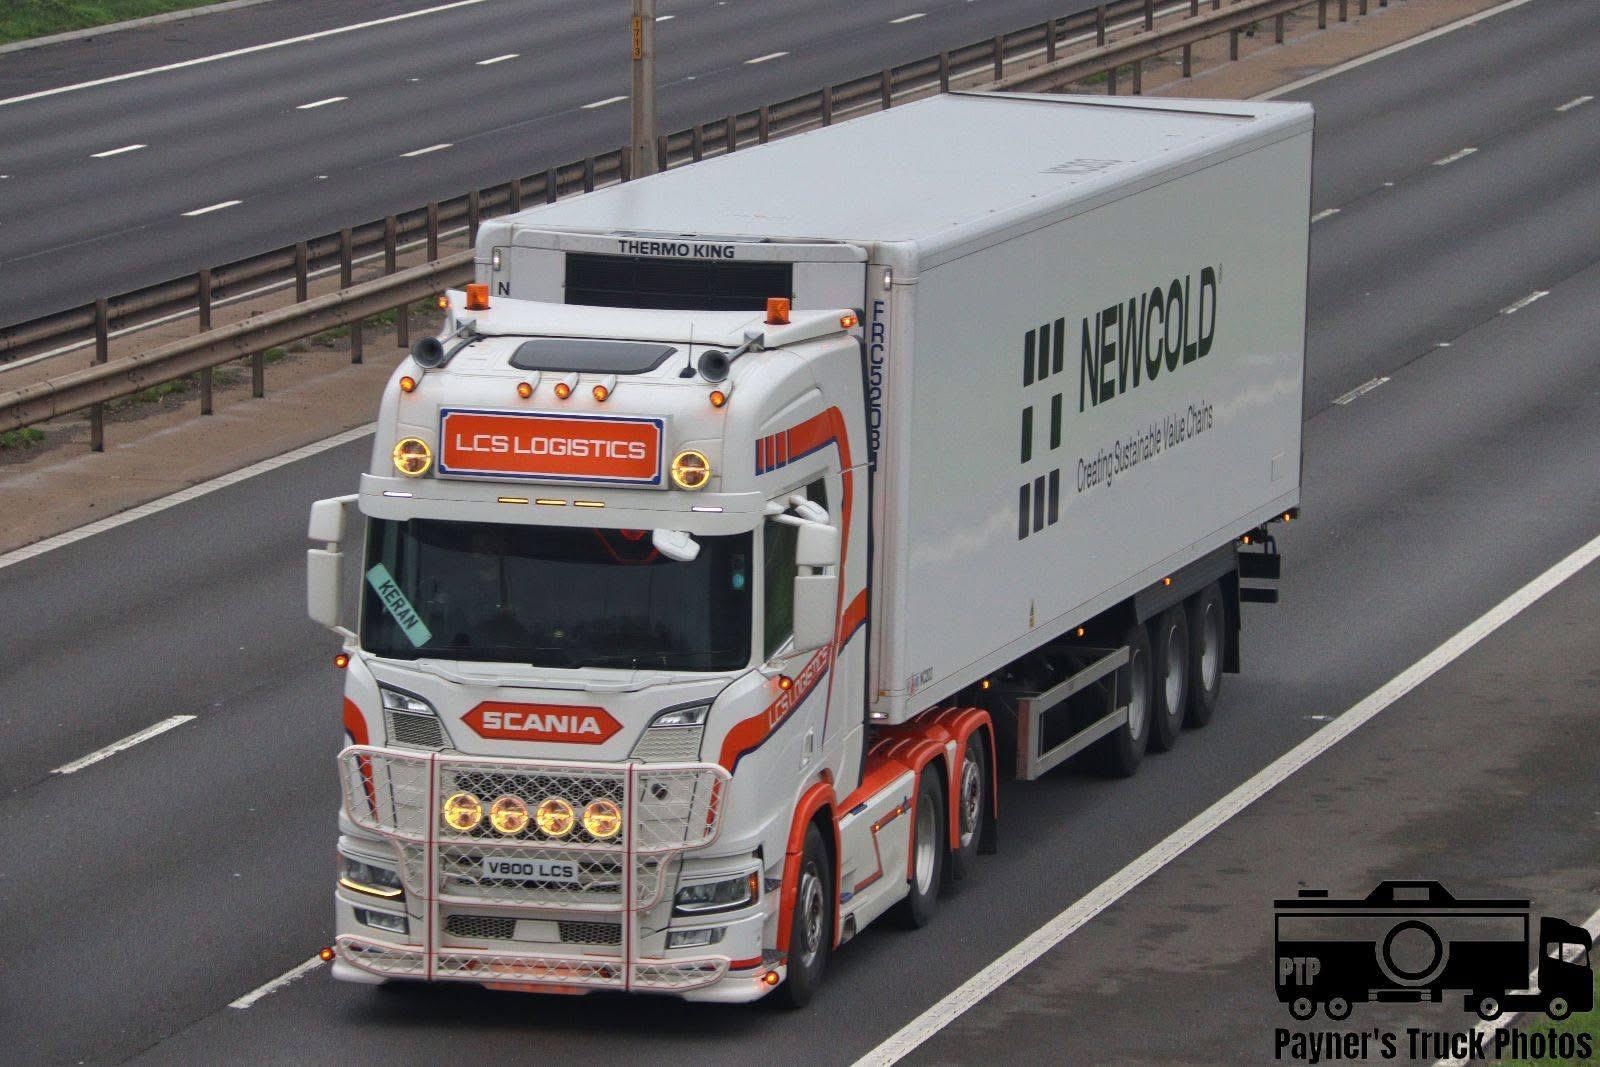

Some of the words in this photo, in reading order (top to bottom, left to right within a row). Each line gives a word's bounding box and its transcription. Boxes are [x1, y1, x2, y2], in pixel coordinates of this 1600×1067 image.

[619, 239, 689, 257] THERMO
[693, 244, 735, 259] KING
[1079, 265, 1217, 413] NEWCOLD
[455, 433, 509, 454] LCS
[513, 436, 646, 460] LOGISTICS
[1077, 449, 1113, 493] Creating
[1114, 423, 1161, 475] Sustainable
[1163, 413, 1185, 450] Value
[1187, 400, 1213, 439] Chains
[378, 579, 419, 630] KERAN
[482, 711, 602, 735] SCANIA
[488, 861, 533, 876] V800
[539, 864, 573, 879] LCS
